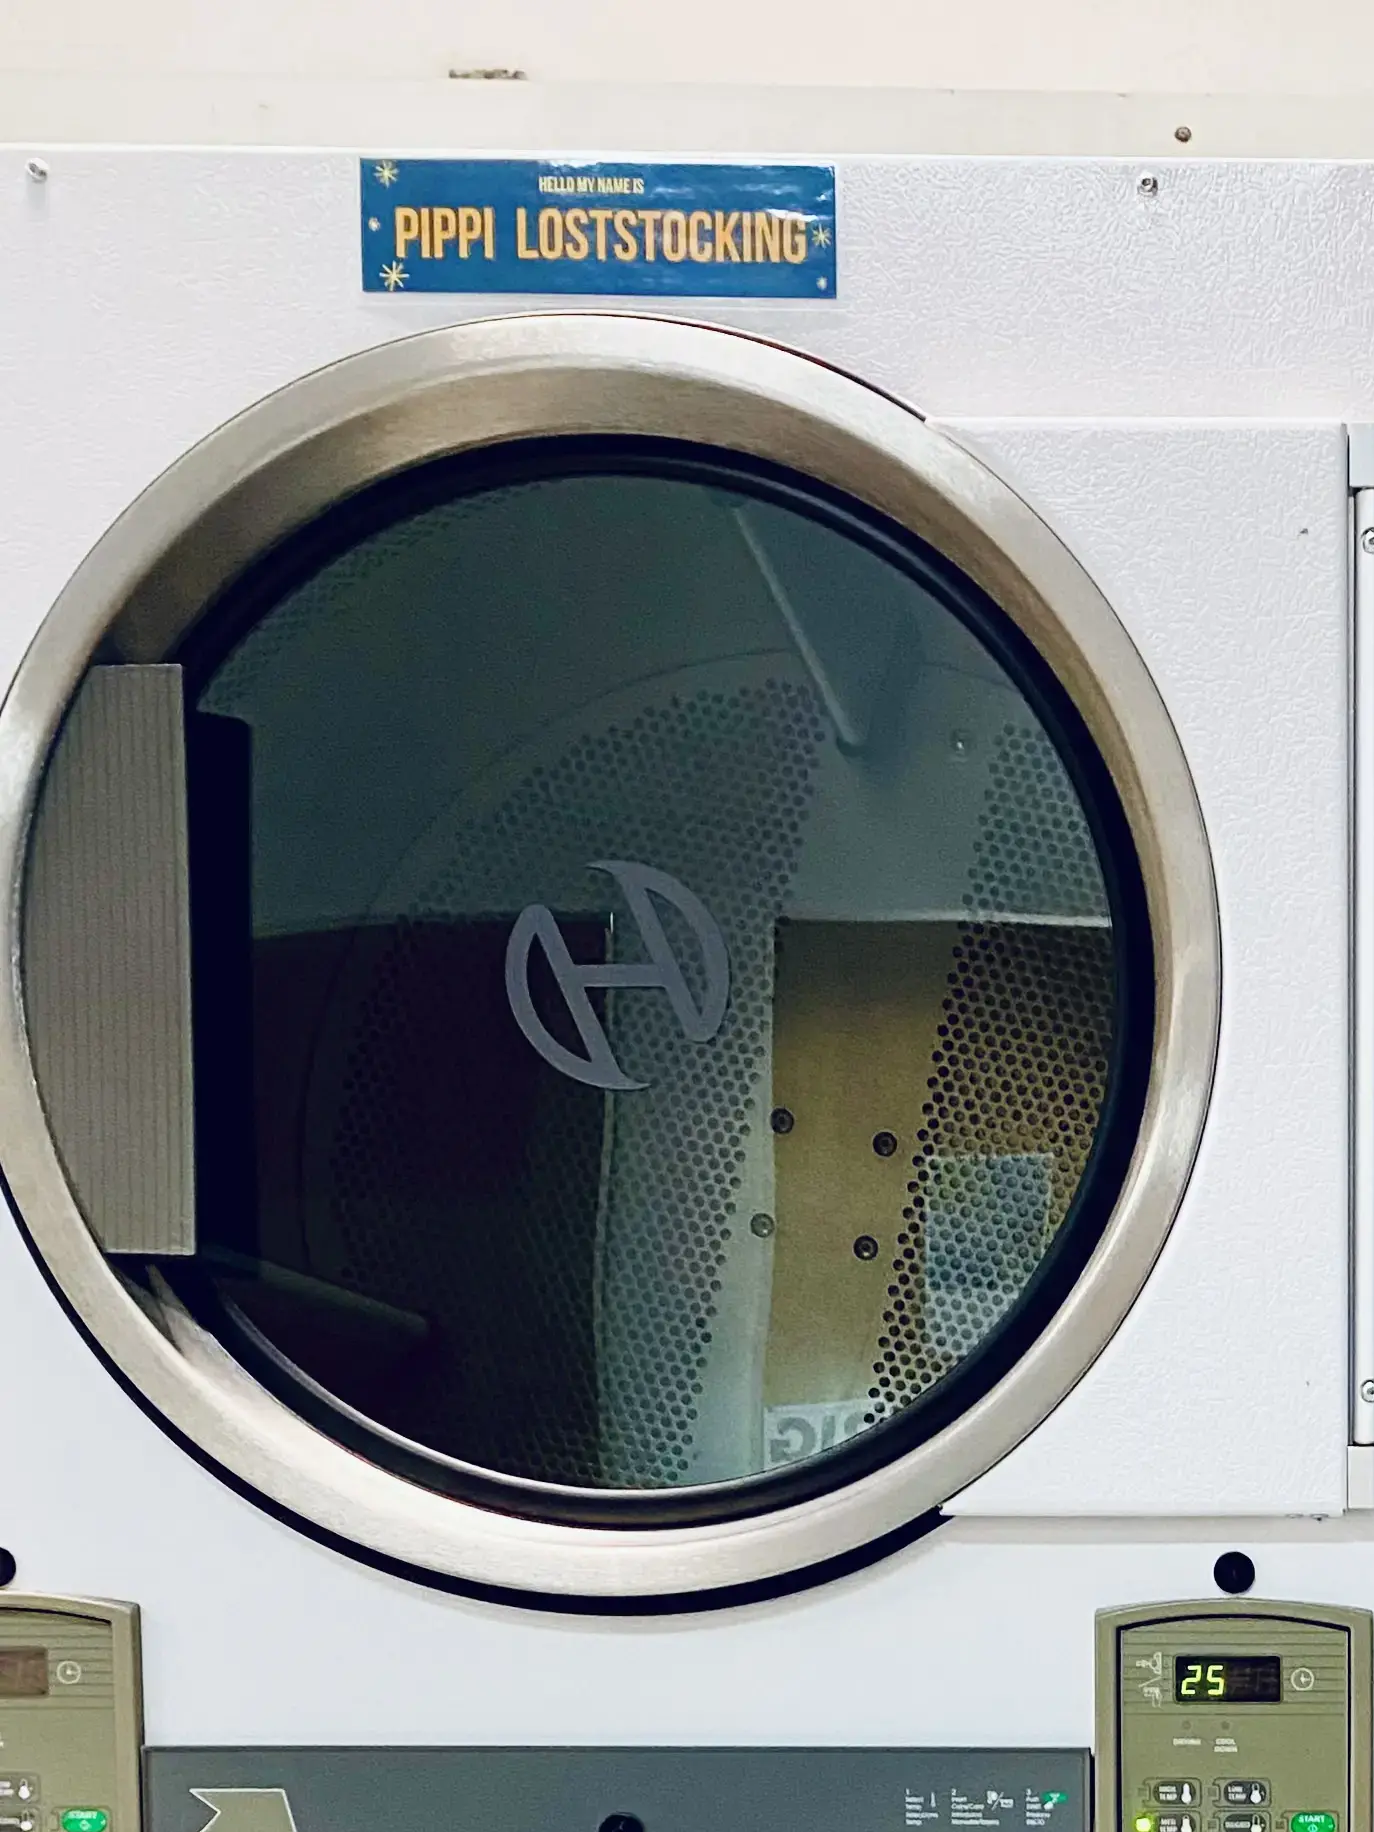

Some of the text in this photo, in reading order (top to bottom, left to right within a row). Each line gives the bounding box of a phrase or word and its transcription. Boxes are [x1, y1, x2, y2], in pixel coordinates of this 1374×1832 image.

[538, 175, 645, 195] HELLO MY NAME IS
[394, 206, 809, 264] PIPPI LOSTSTOCKING
[1180, 1665, 1225, 1696] 25
[1298, 1814, 1325, 1824] START
